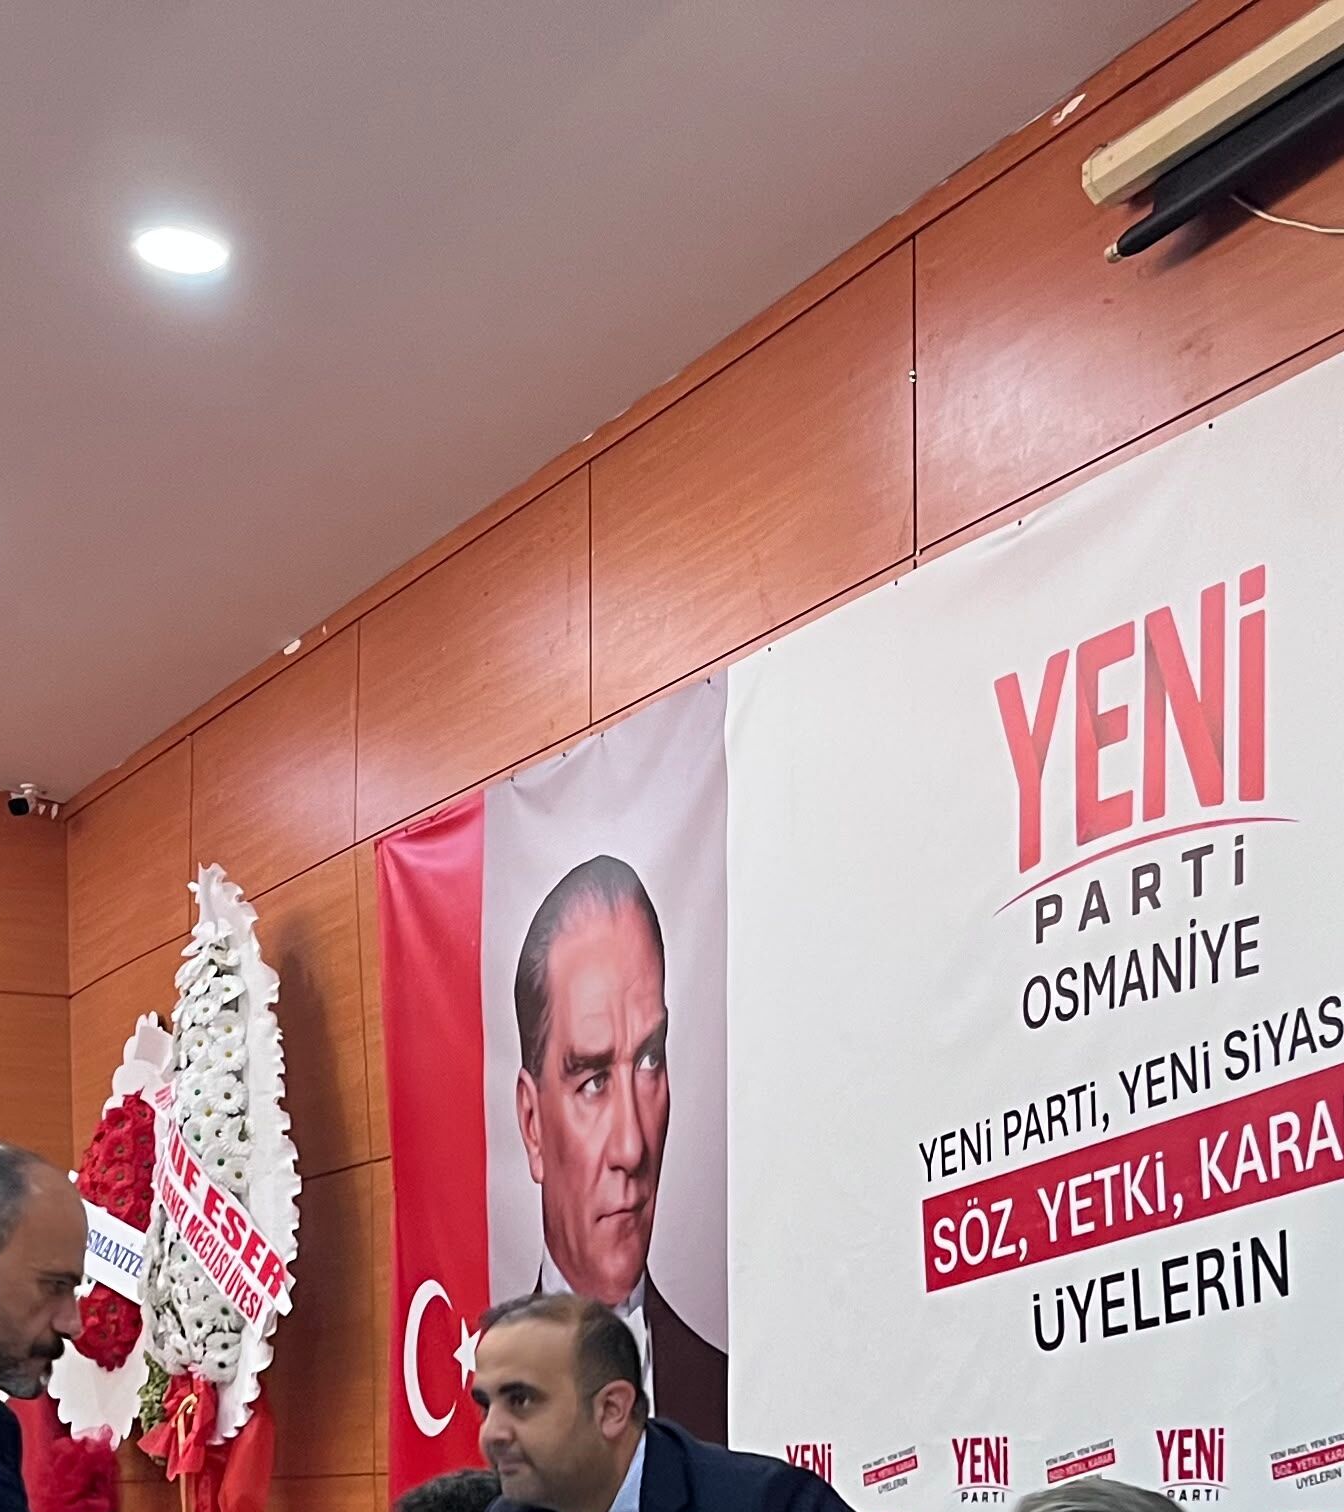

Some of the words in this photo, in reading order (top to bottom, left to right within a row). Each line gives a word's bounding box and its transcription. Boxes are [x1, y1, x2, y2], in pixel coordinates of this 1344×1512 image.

[1022, 917, 1260, 1030] OSMANİYE
[204, 1184, 284, 1298] ESER
[932, 1197, 1028, 1275] SÖZ,
